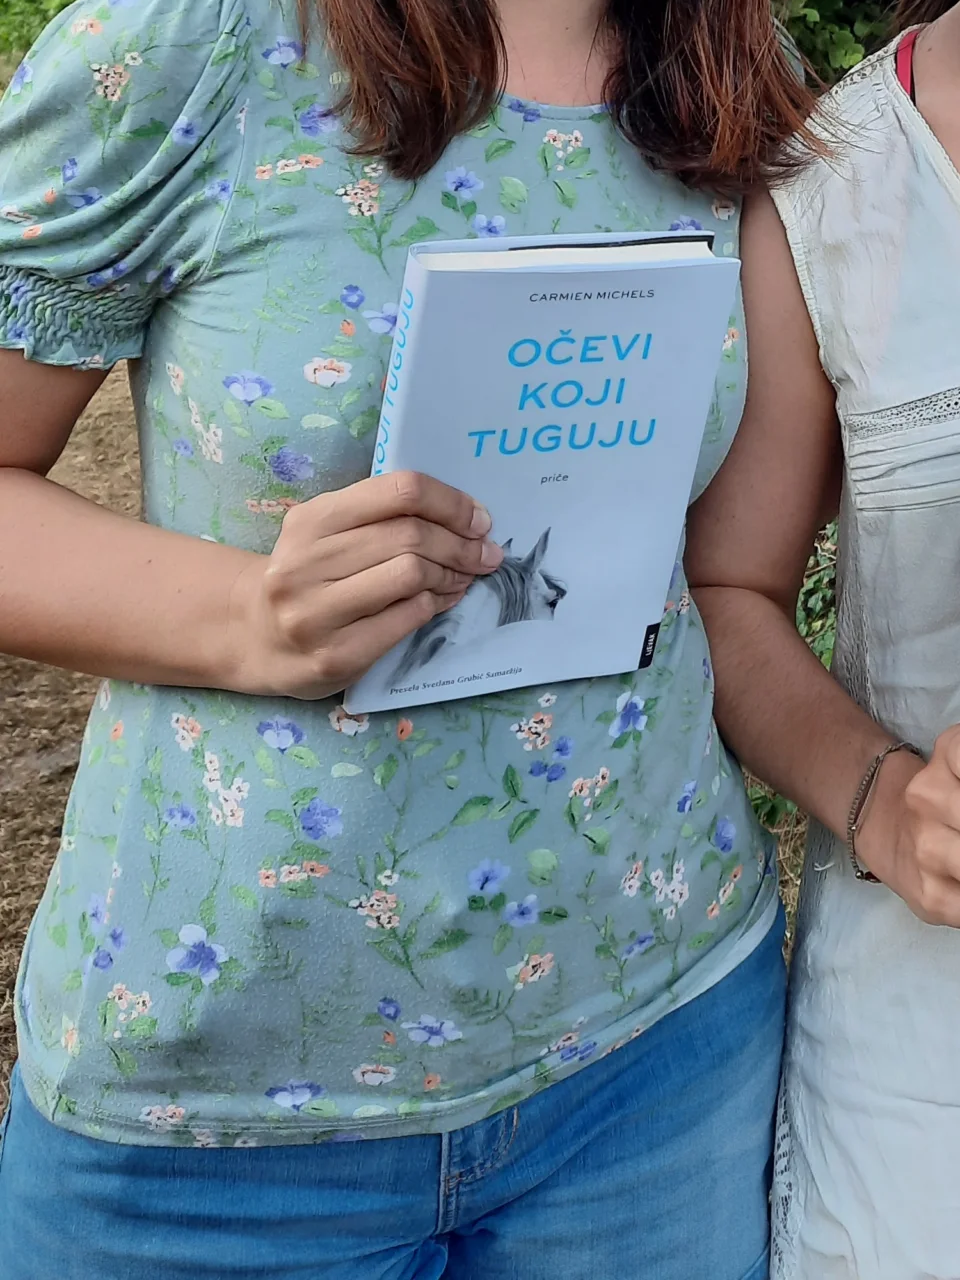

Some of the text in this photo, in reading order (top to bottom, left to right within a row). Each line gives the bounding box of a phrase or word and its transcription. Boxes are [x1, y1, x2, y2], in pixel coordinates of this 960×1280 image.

[529, 289, 655, 302] CARMIEN MICHELS
[384, 288, 414, 407] TUGUJU
[508, 328, 653, 367] OČEVI
[517, 378, 626, 411] KOJI
[467, 418, 656, 458] TUGUJU
[540, 472, 569, 485] priče
